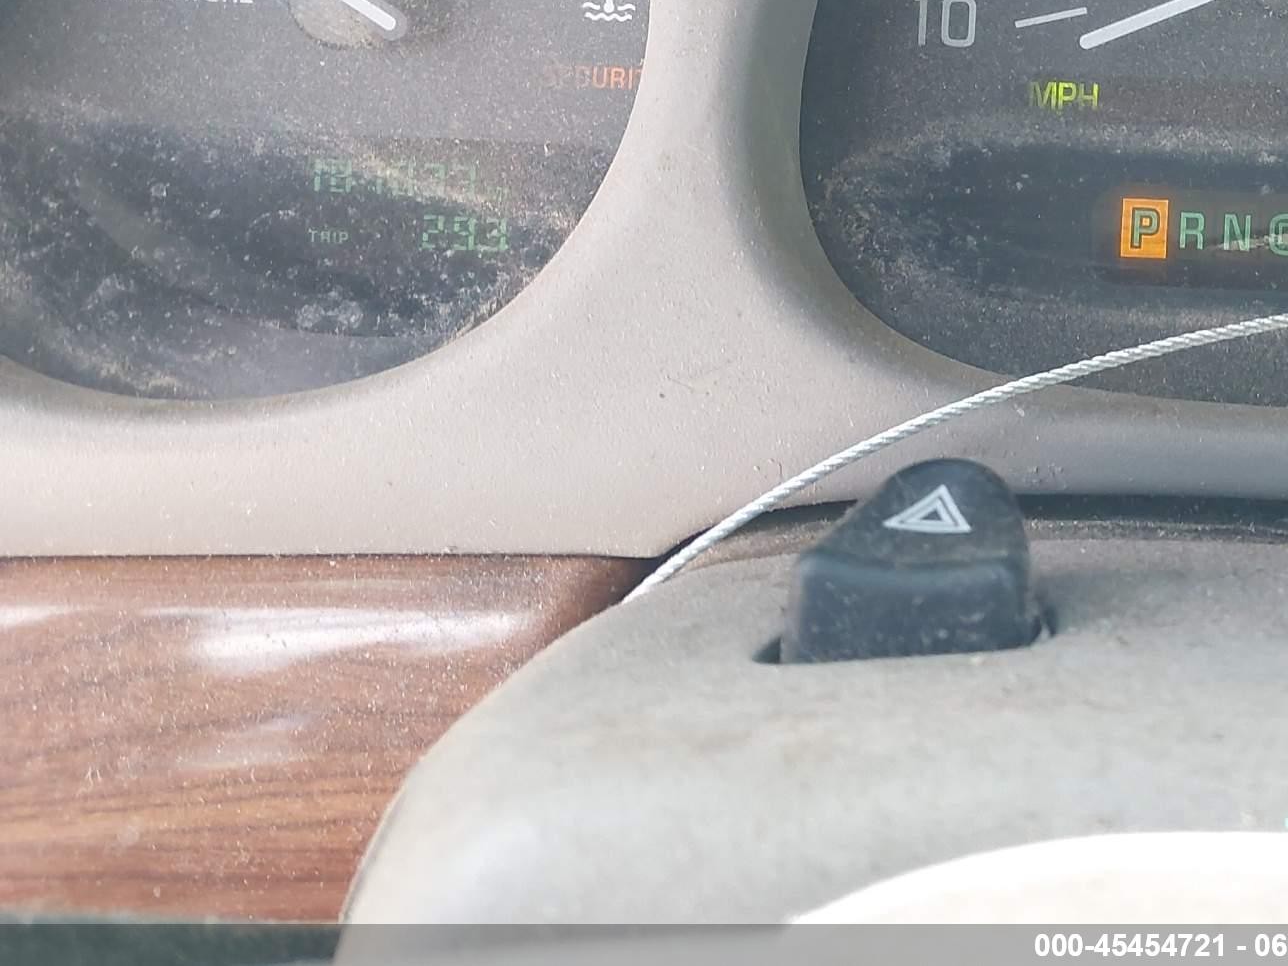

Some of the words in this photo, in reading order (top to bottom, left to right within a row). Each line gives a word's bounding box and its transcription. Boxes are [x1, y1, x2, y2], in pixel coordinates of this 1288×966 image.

[1029, 82, 1100, 108] MPH
[309, 230, 349, 243] TRIP
[1131, 207, 1160, 249] P
[1179, 212, 1206, 250] R
[1223, 214, 1252, 252] N
